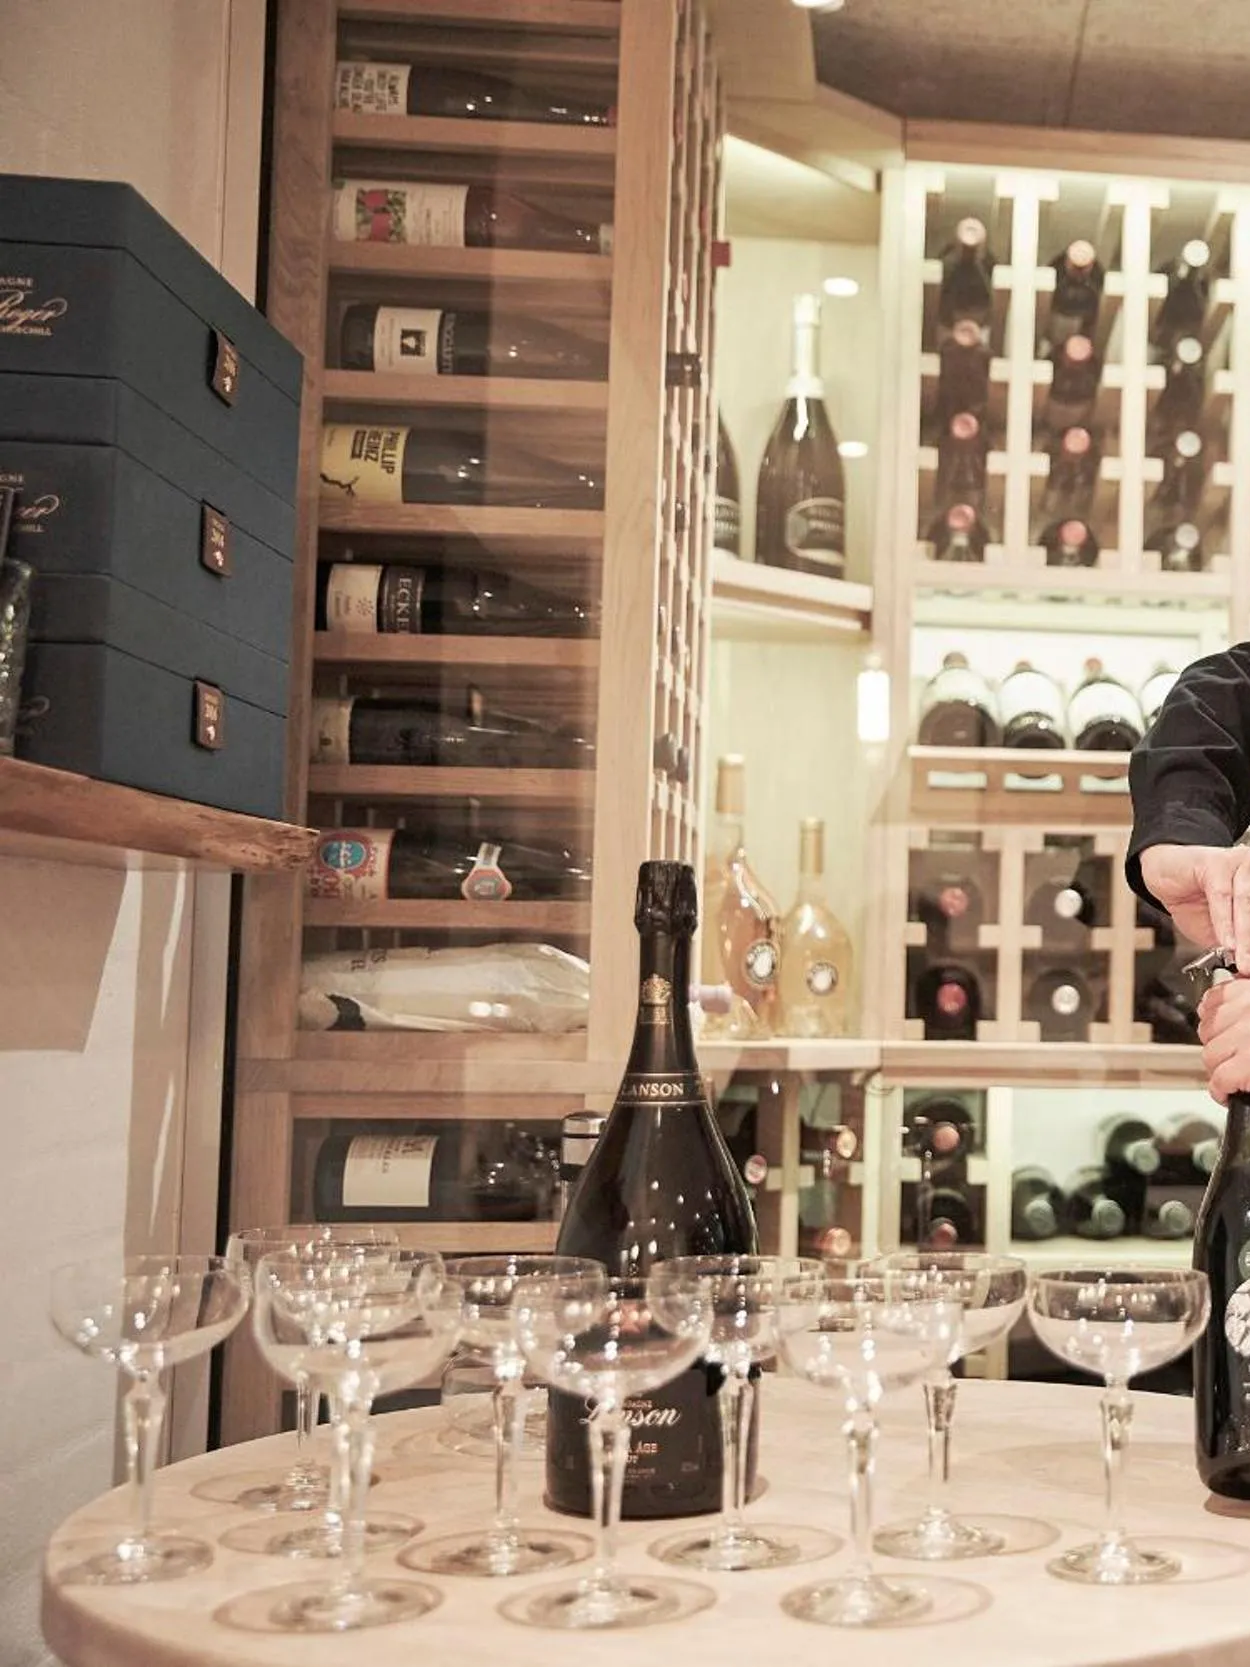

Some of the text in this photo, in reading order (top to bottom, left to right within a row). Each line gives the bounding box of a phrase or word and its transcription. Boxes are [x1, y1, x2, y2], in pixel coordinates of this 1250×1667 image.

[381, 431, 400, 474] PHILLIP
[621, 1082, 684, 1097] LANSON
[579, 1394, 681, 1427] Lnson
